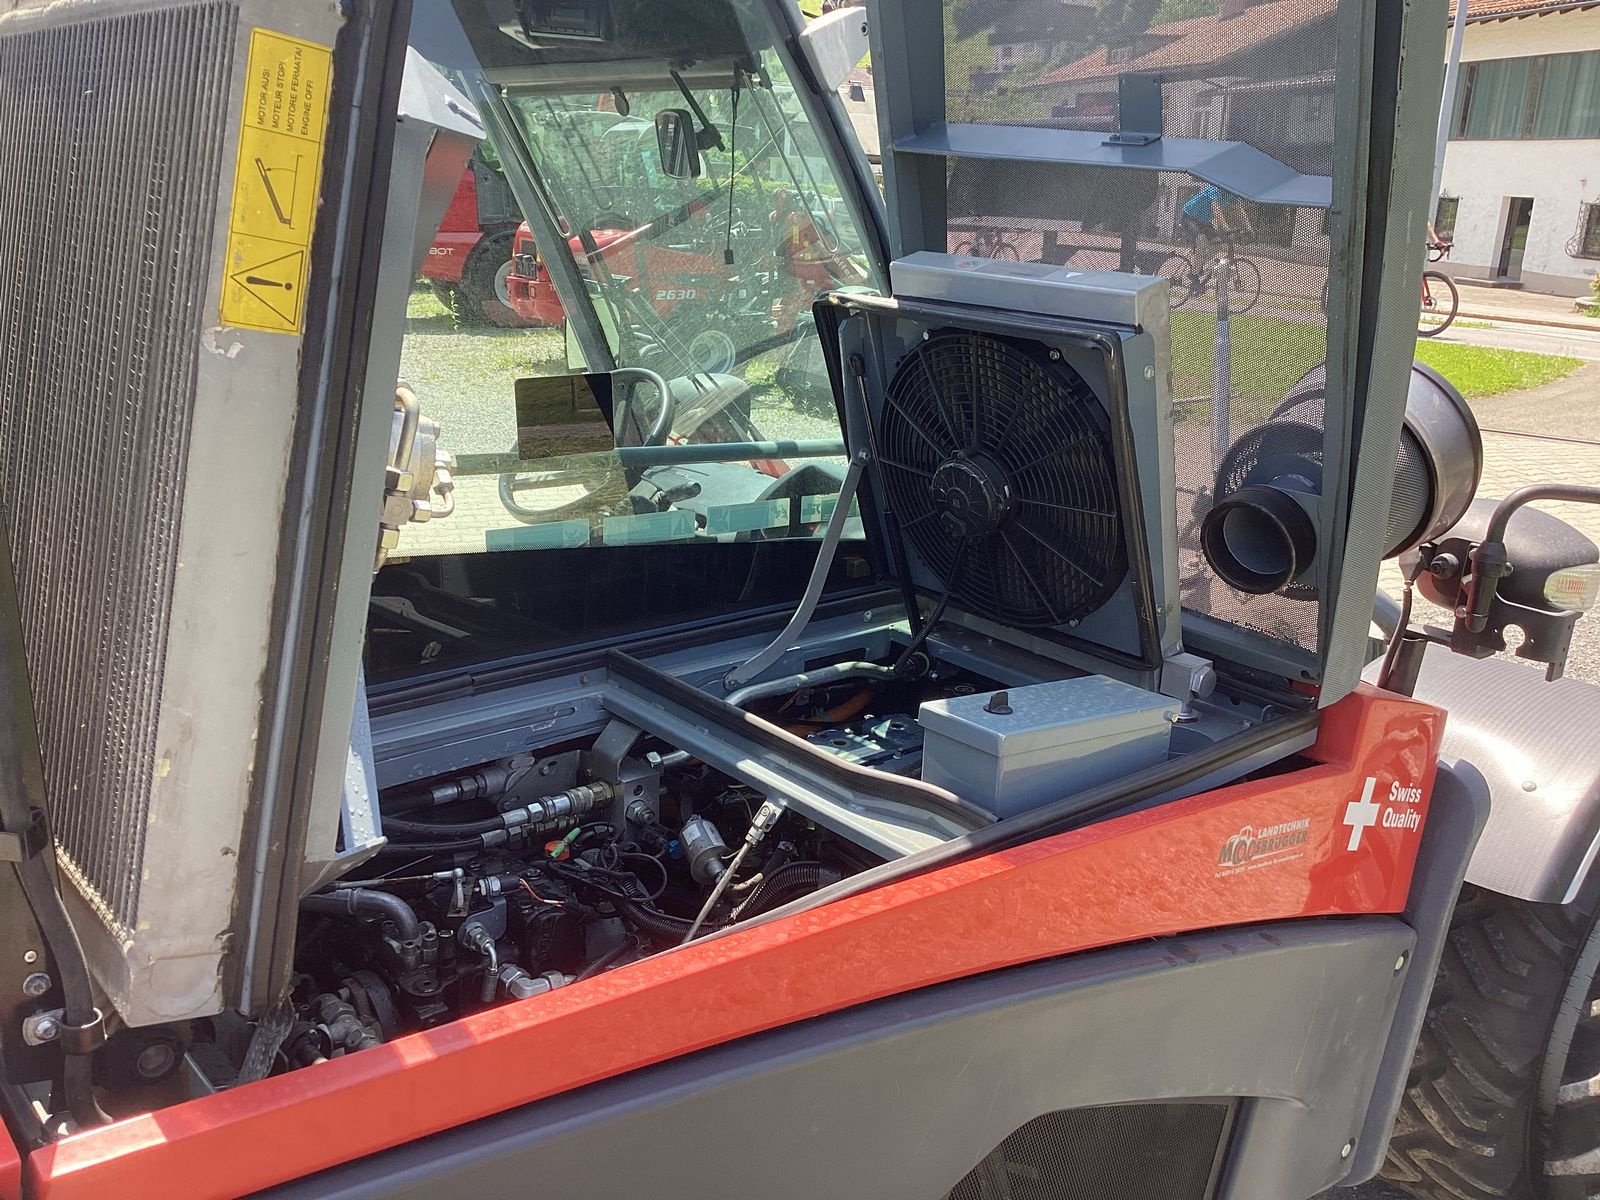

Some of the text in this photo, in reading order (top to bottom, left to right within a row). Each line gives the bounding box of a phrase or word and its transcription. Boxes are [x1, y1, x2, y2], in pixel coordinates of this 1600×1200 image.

[272, 60, 286, 129] MOTEUR STOP!
[286, 47, 303, 132] MOTORE FERMATA!
[257, 91, 267, 125] MOTOR
[301, 79, 314, 136] ENGINE OFF!
[656, 289, 697, 300] 2630
[1389, 780, 1422, 803] Swiss
[1257, 817, 1311, 839] LANDTECHNIK
[1382, 806, 1422, 833] Quality
